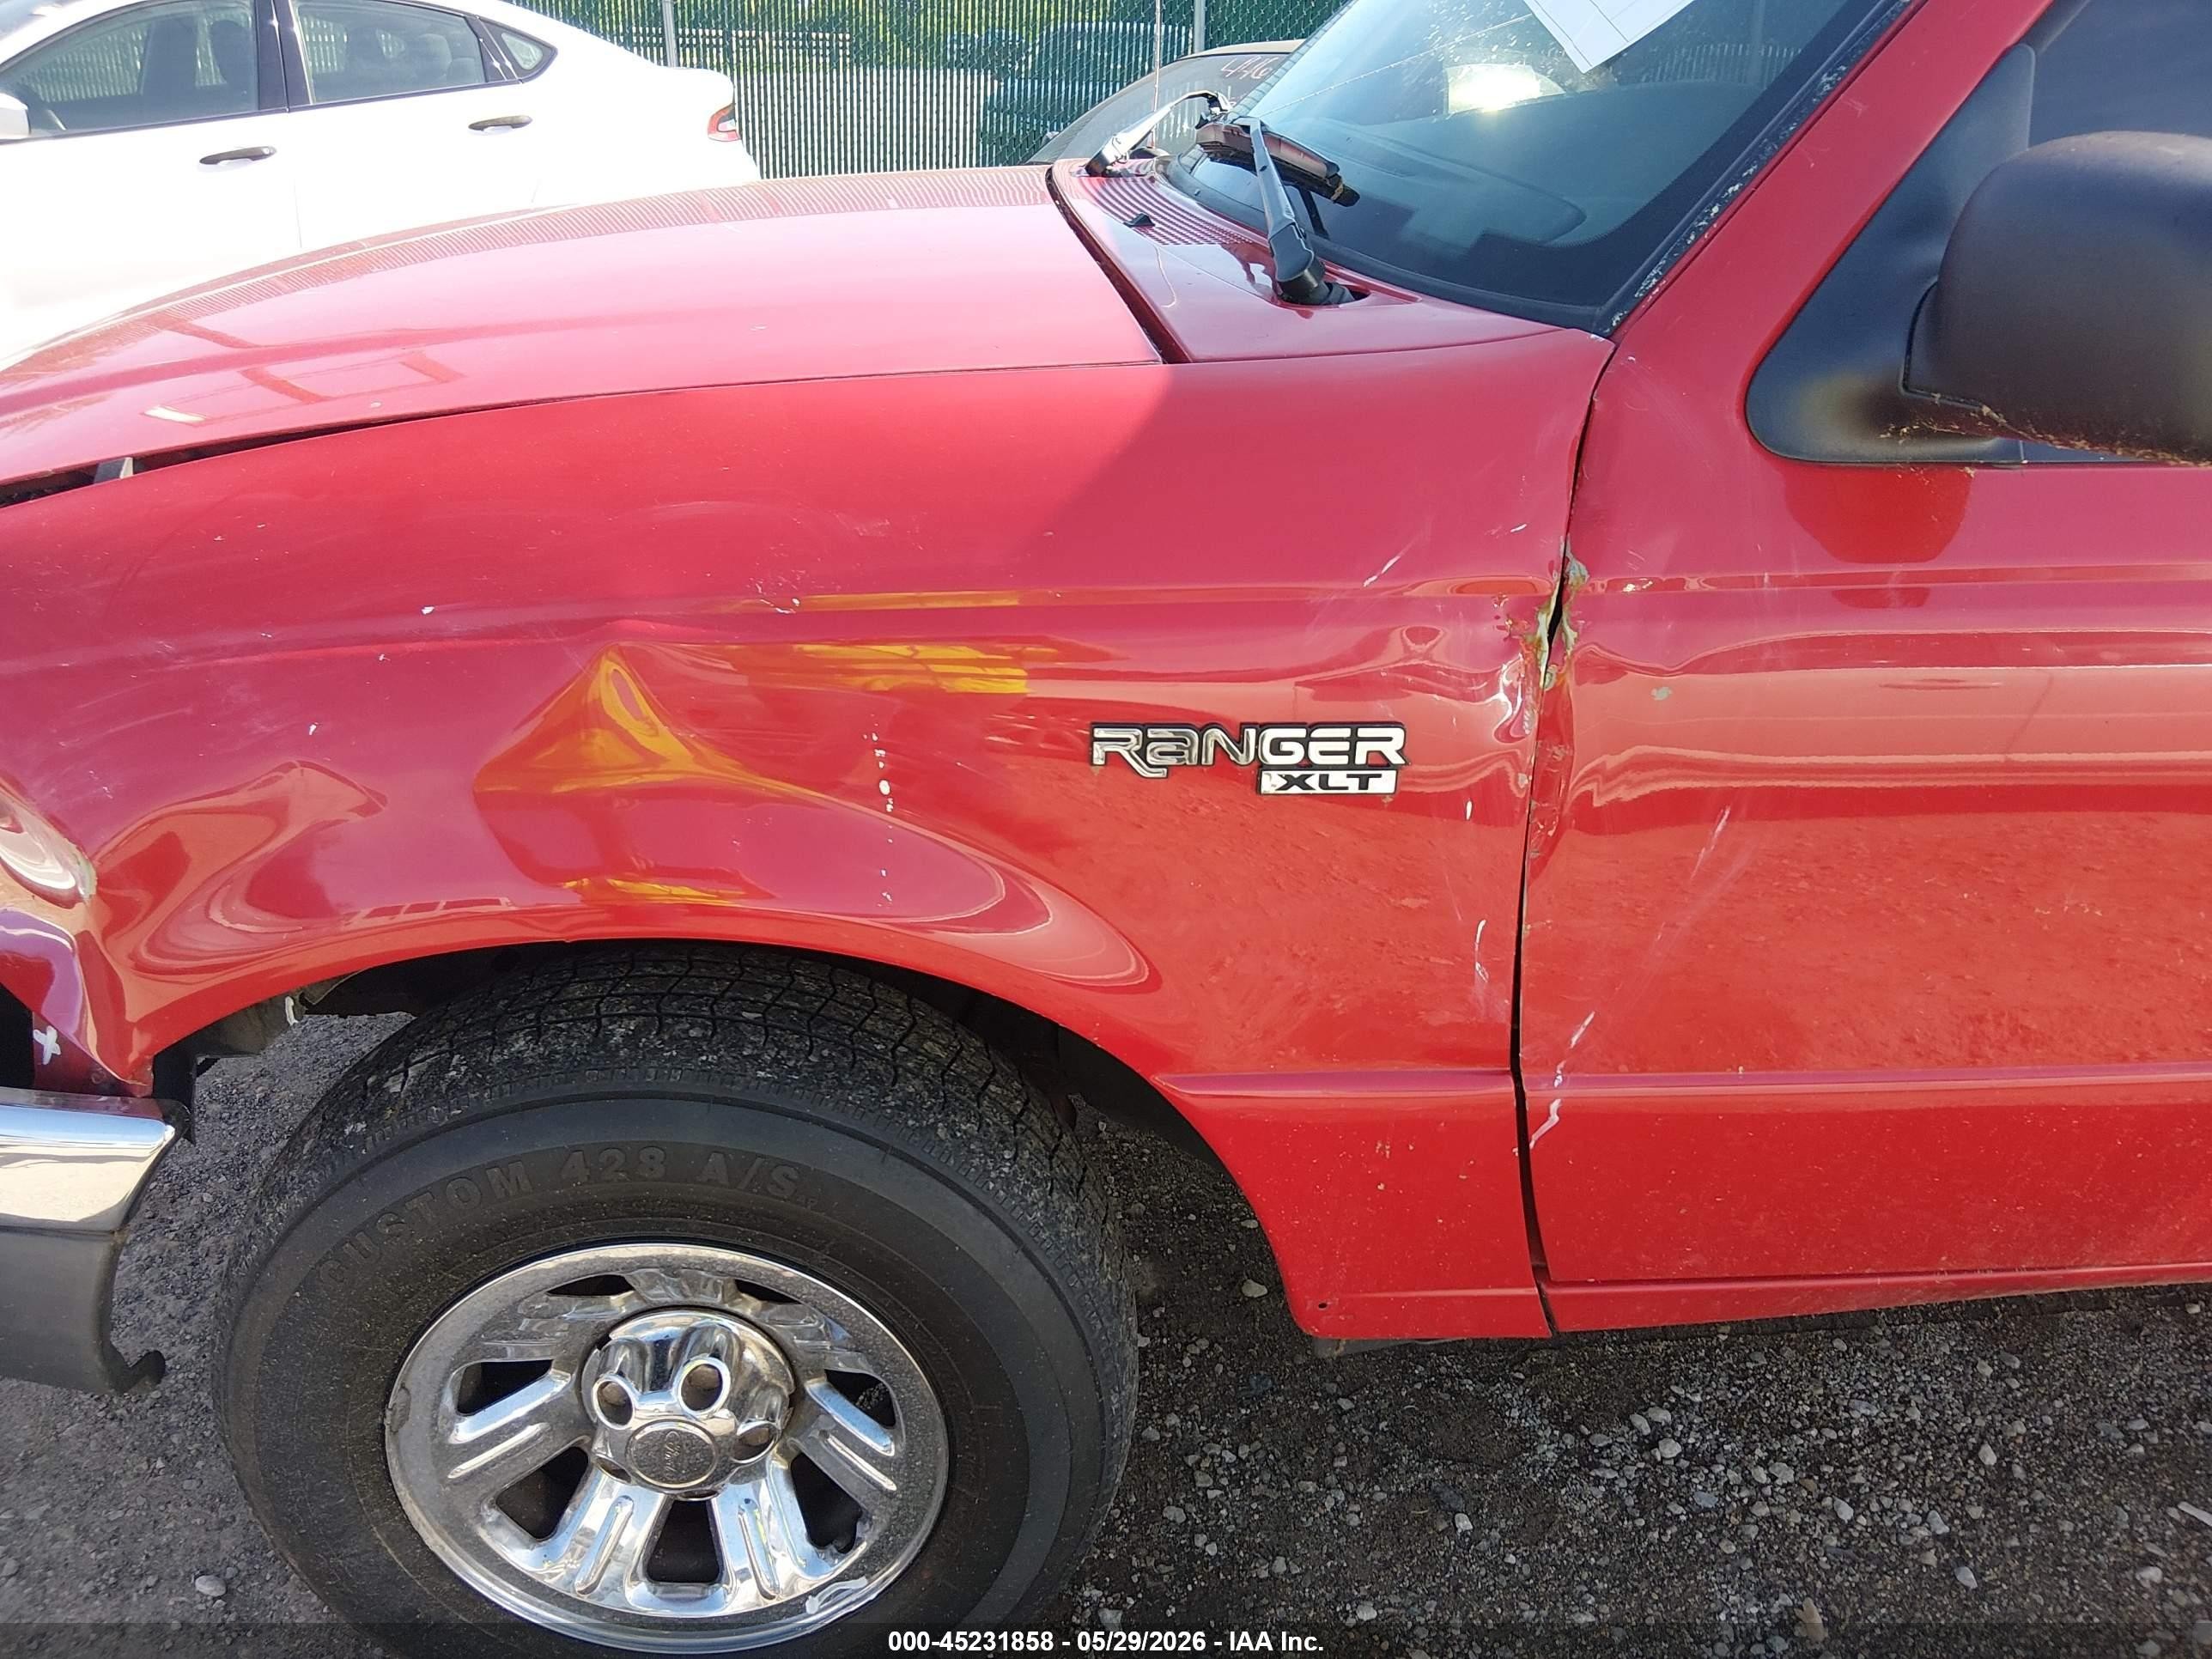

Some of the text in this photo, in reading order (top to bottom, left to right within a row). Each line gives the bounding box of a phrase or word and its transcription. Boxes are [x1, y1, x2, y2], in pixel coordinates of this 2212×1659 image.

[1274, 773, 1382, 791] XLT
[319, 1146, 799, 1288] CUSTOM 428 A/S
